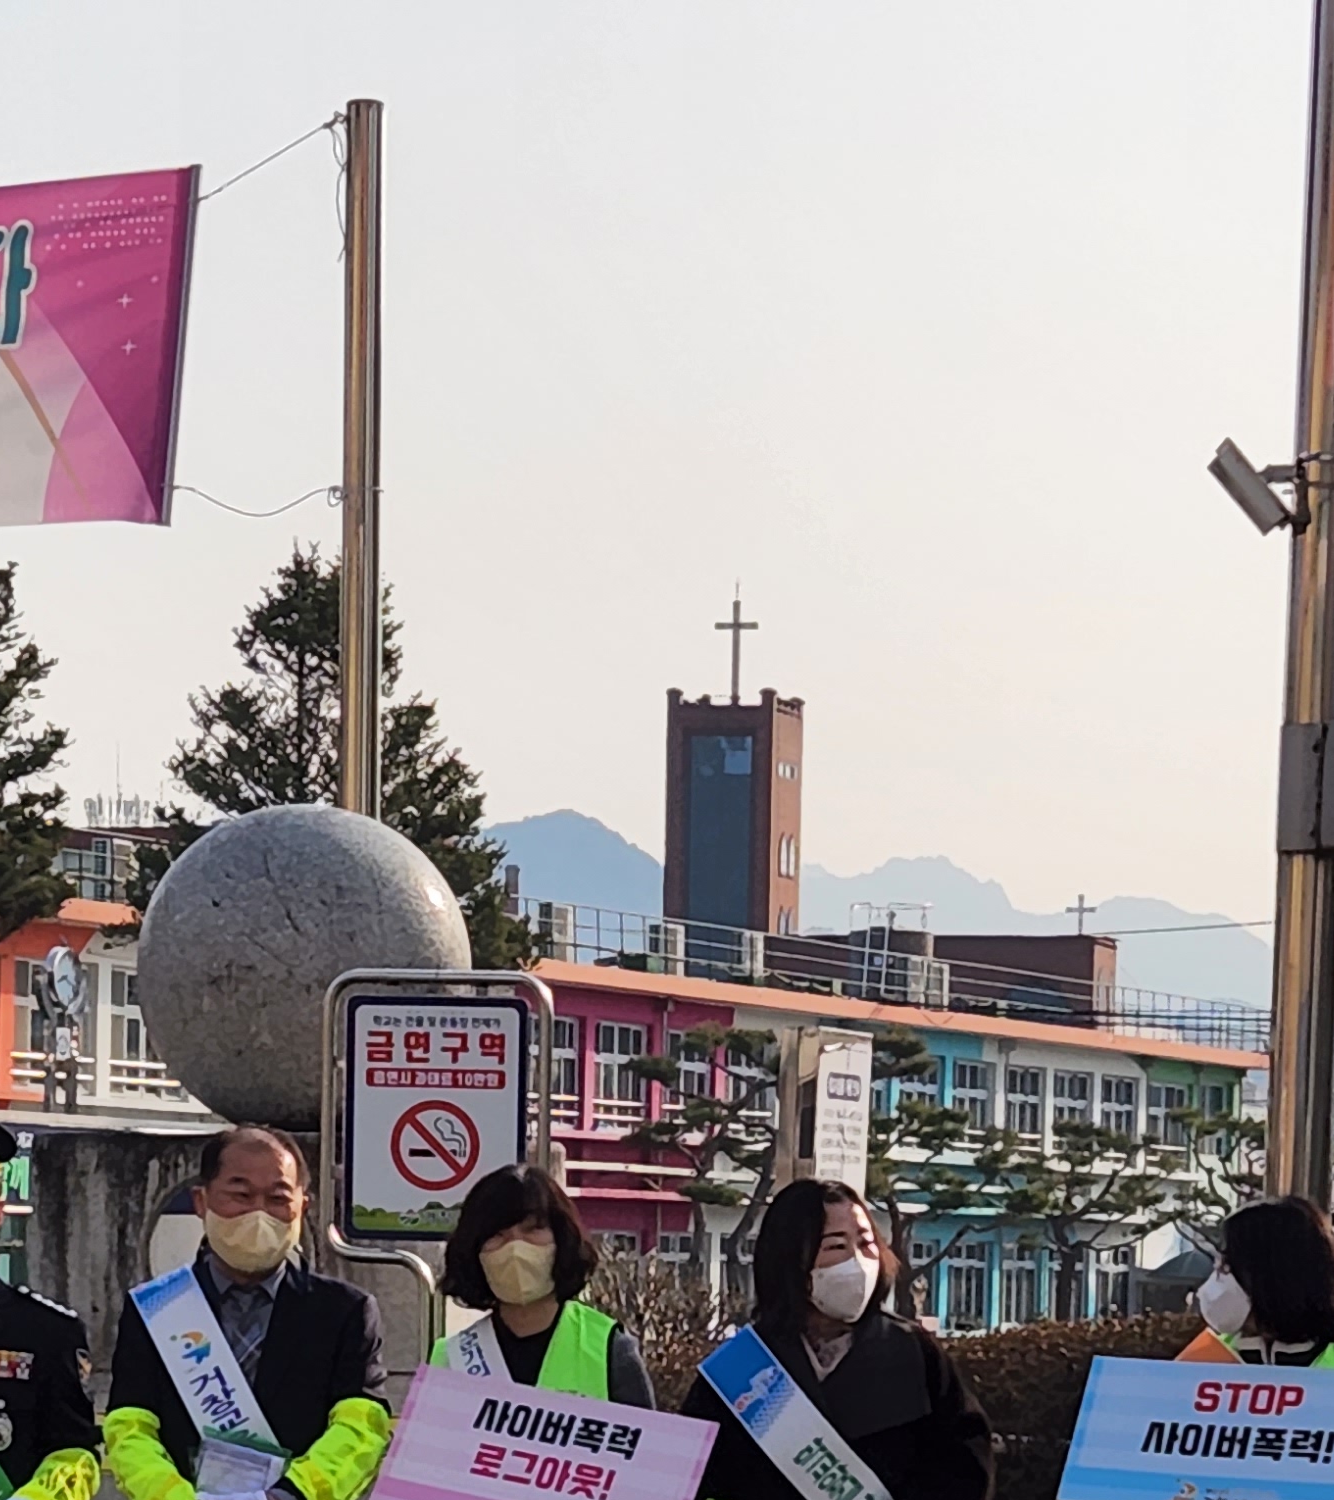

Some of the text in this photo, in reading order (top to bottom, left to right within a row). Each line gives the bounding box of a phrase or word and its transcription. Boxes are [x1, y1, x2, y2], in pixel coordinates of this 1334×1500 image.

[365, 1030, 506, 1065] 금연구역
[1193, 1382, 1305, 1416] STOP
[472, 1397, 643, 1460] 사이버폭력
